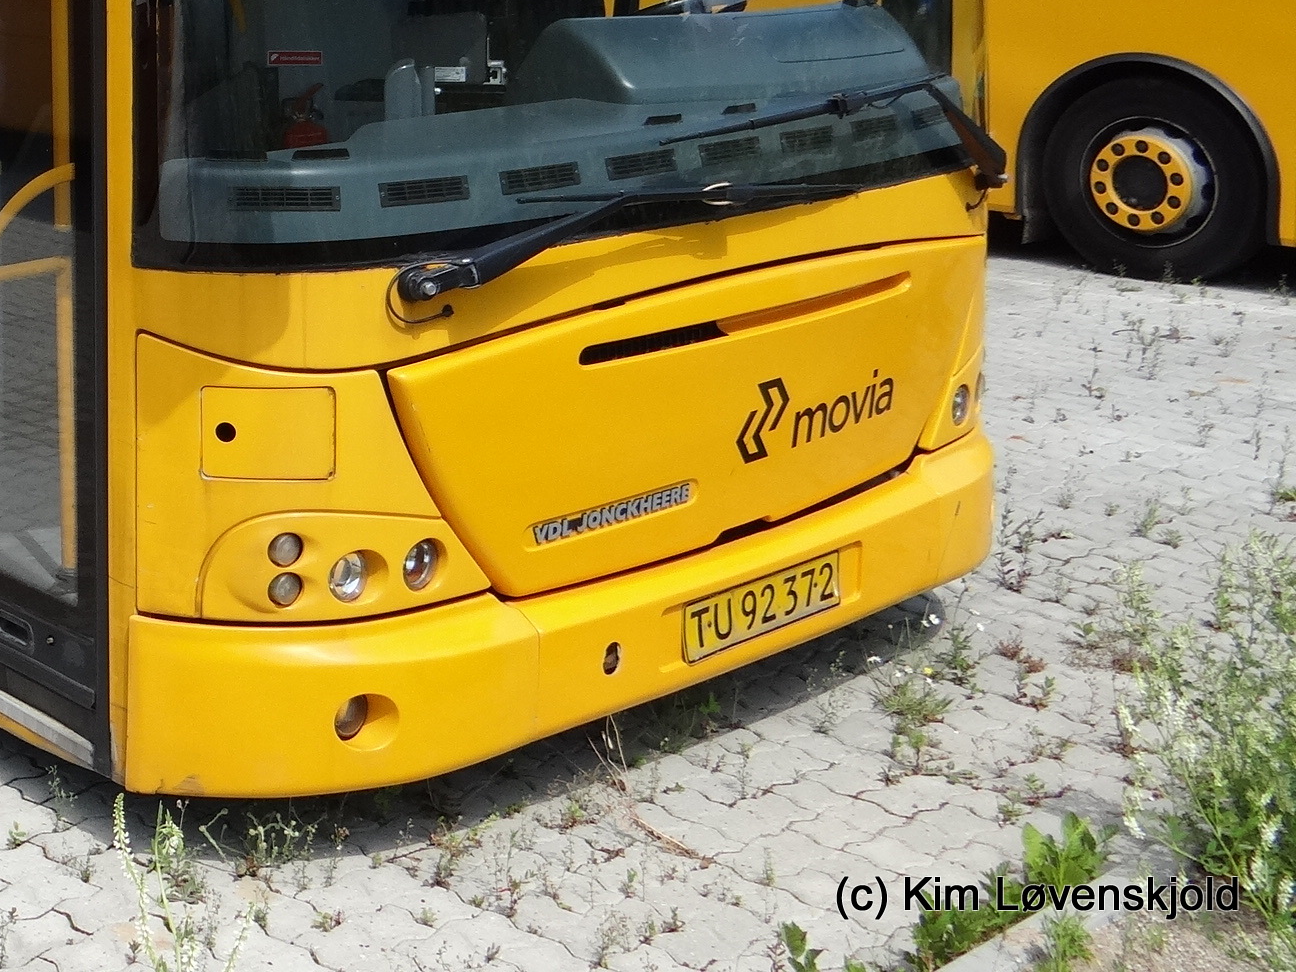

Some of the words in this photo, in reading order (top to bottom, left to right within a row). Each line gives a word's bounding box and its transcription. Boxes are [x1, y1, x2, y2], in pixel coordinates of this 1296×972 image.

[791, 368, 894, 449] movia
[532, 516, 574, 545] VDL
[576, 483, 692, 531] JONCKHEERE
